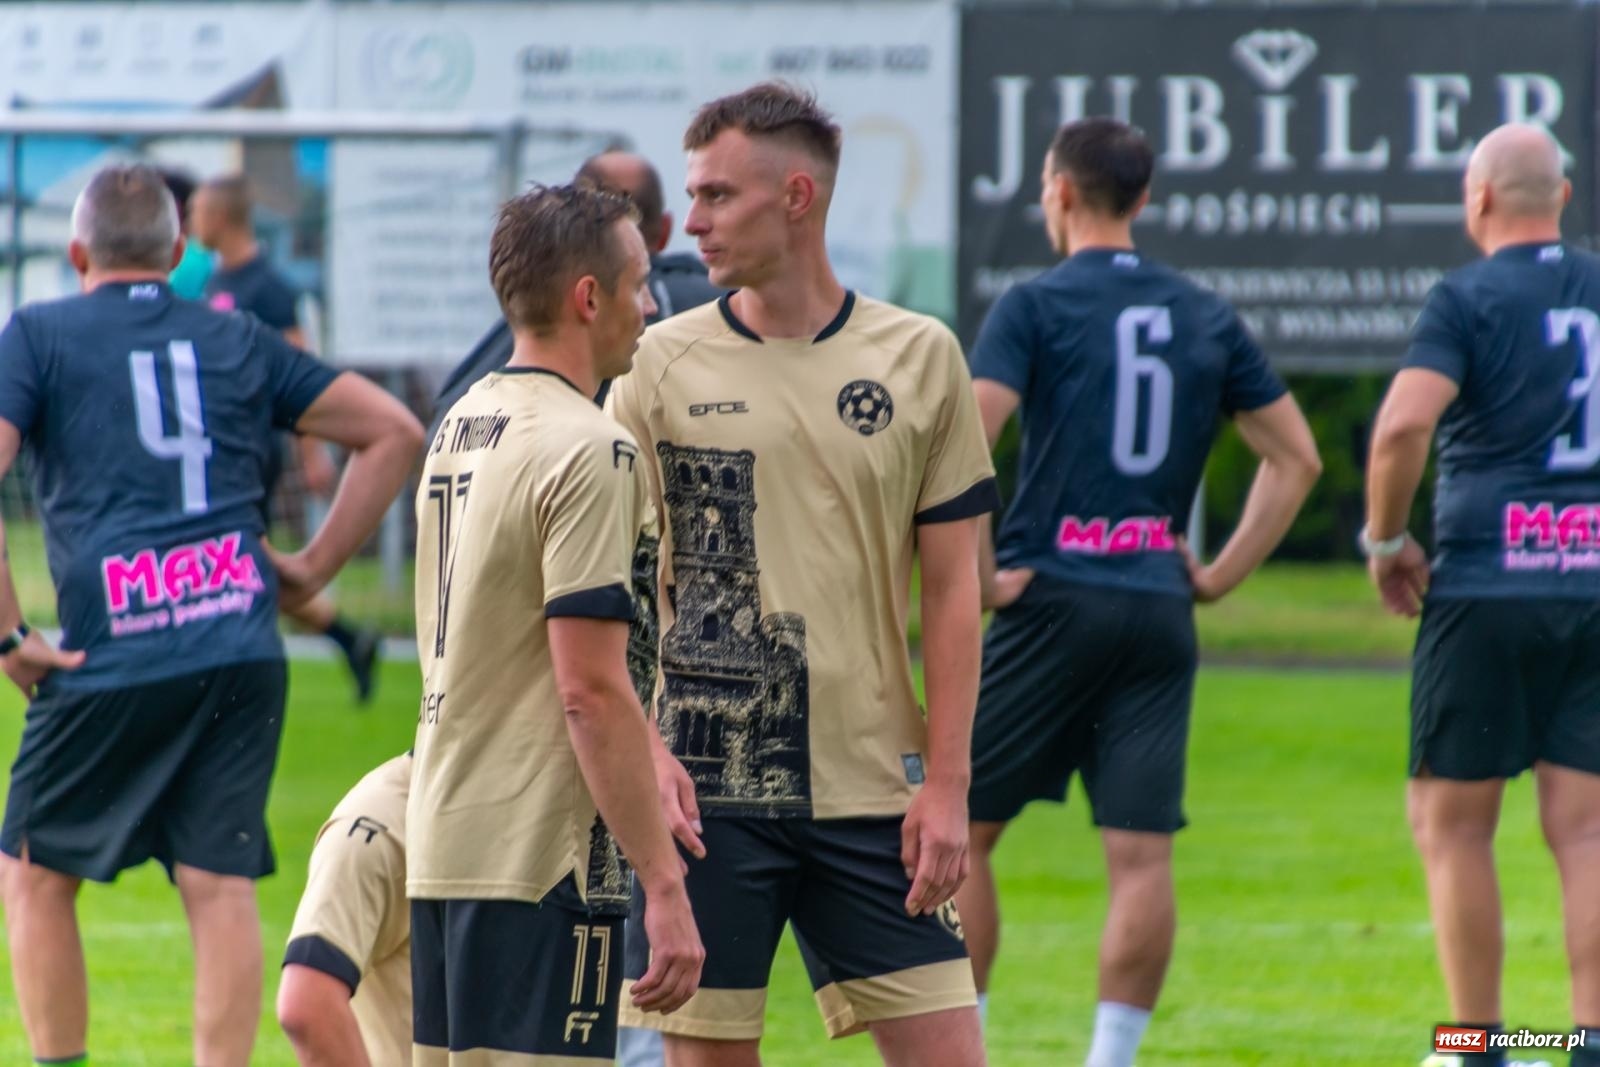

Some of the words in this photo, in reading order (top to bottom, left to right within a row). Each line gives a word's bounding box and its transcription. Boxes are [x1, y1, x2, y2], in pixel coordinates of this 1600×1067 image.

[1165, 188, 1382, 236] POŚPIECH
[129, 339, 213, 514] 4
[1112, 305, 1174, 476] 6
[1546, 306, 1600, 473] 3
[101, 531, 246, 615] MAX
[569, 924, 611, 1006] 11
